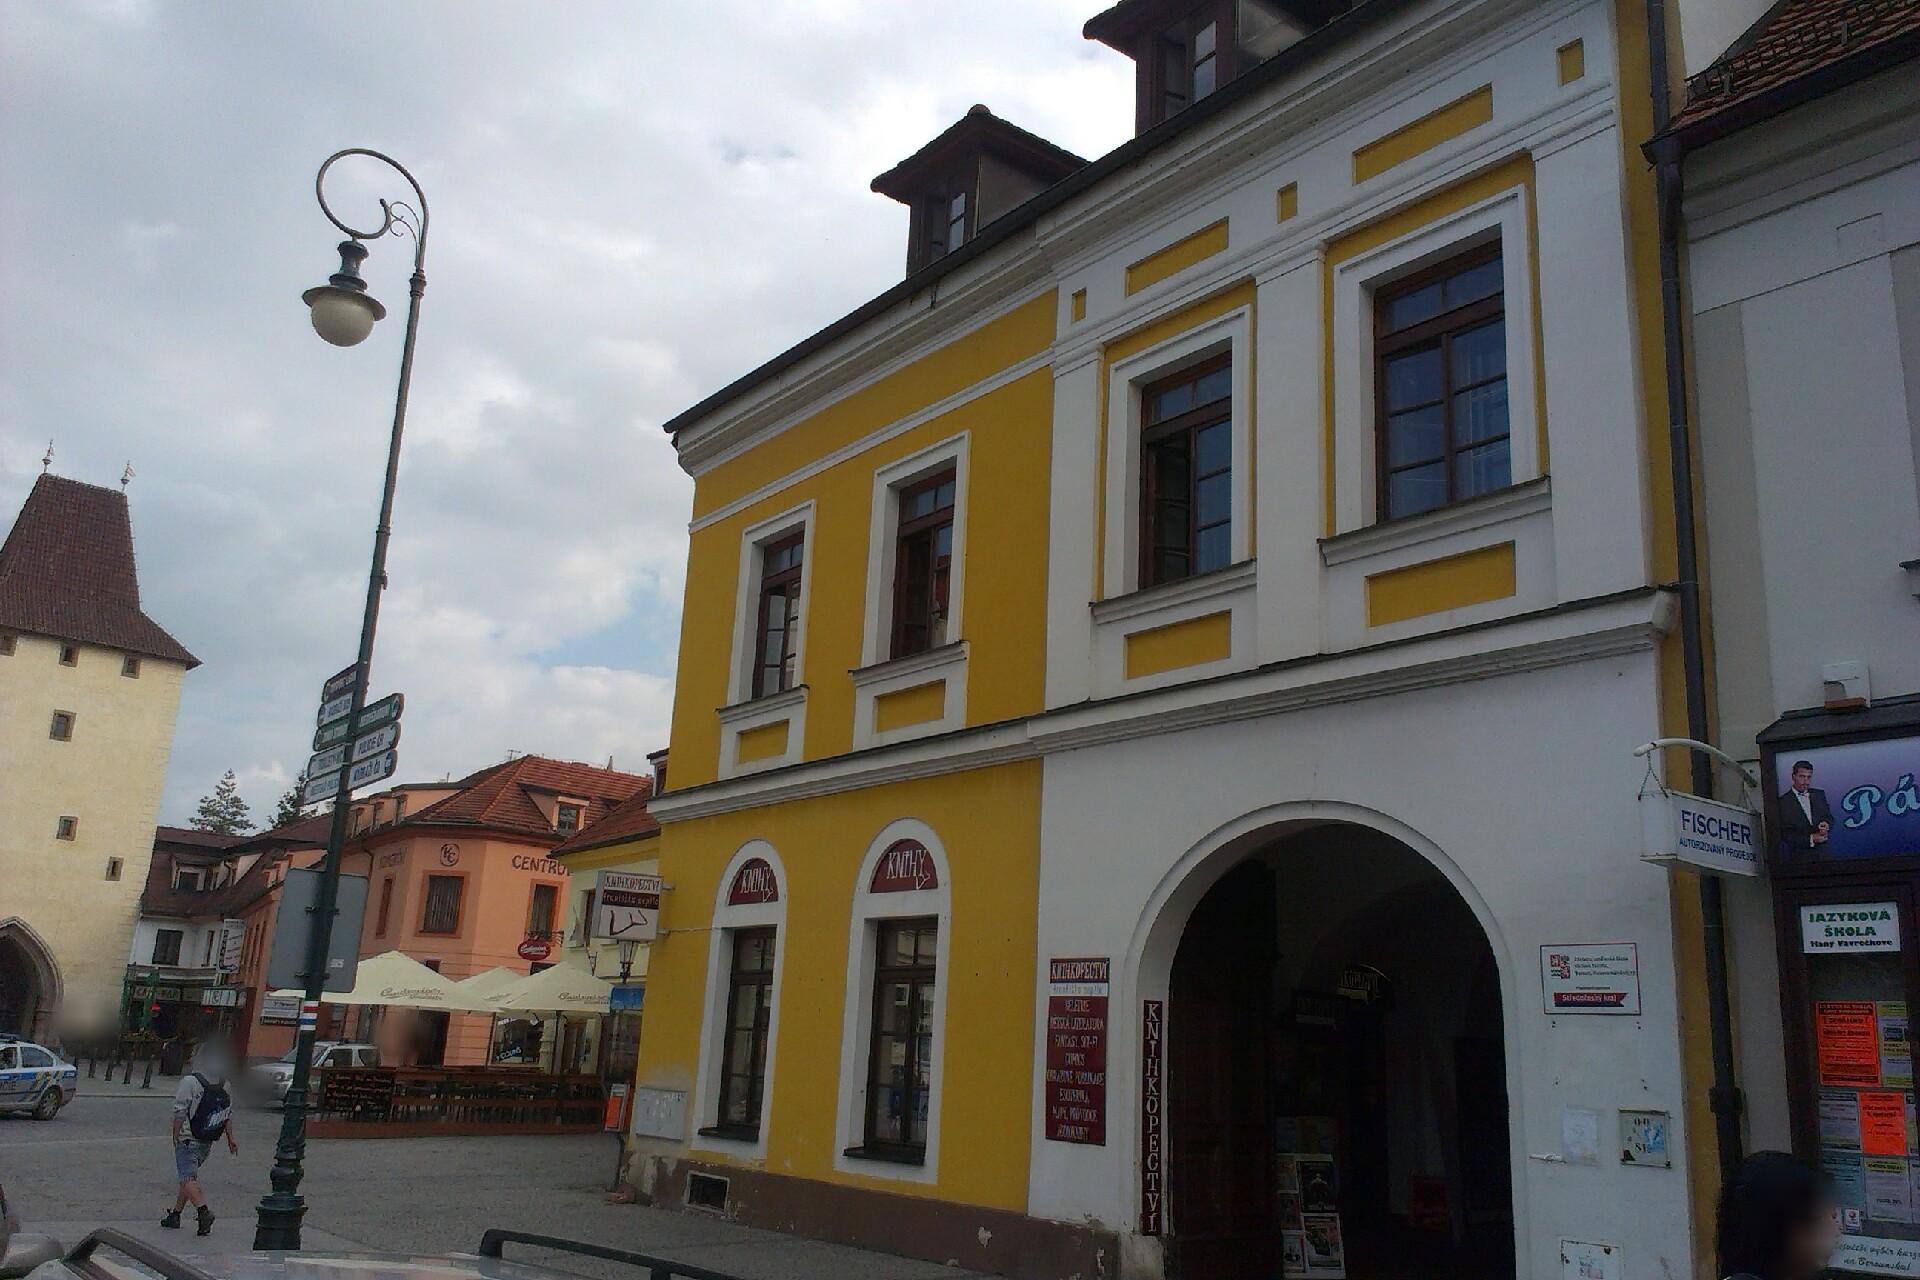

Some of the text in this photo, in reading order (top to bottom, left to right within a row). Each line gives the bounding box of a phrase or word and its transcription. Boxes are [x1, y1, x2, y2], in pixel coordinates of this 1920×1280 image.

[1681, 809, 1753, 846] FISCHER
[511, 855, 571, 877] CENTRU
[887, 850, 928, 880] KNIHY
[740, 867, 773, 894] KNIHY
[1808, 908, 1891, 923] JAZYKOVÁ
[1824, 925, 1877, 937] ŠKOLA
[1810, 940, 1834, 949] Hany
[1603, 994, 1617, 1003] kraj
